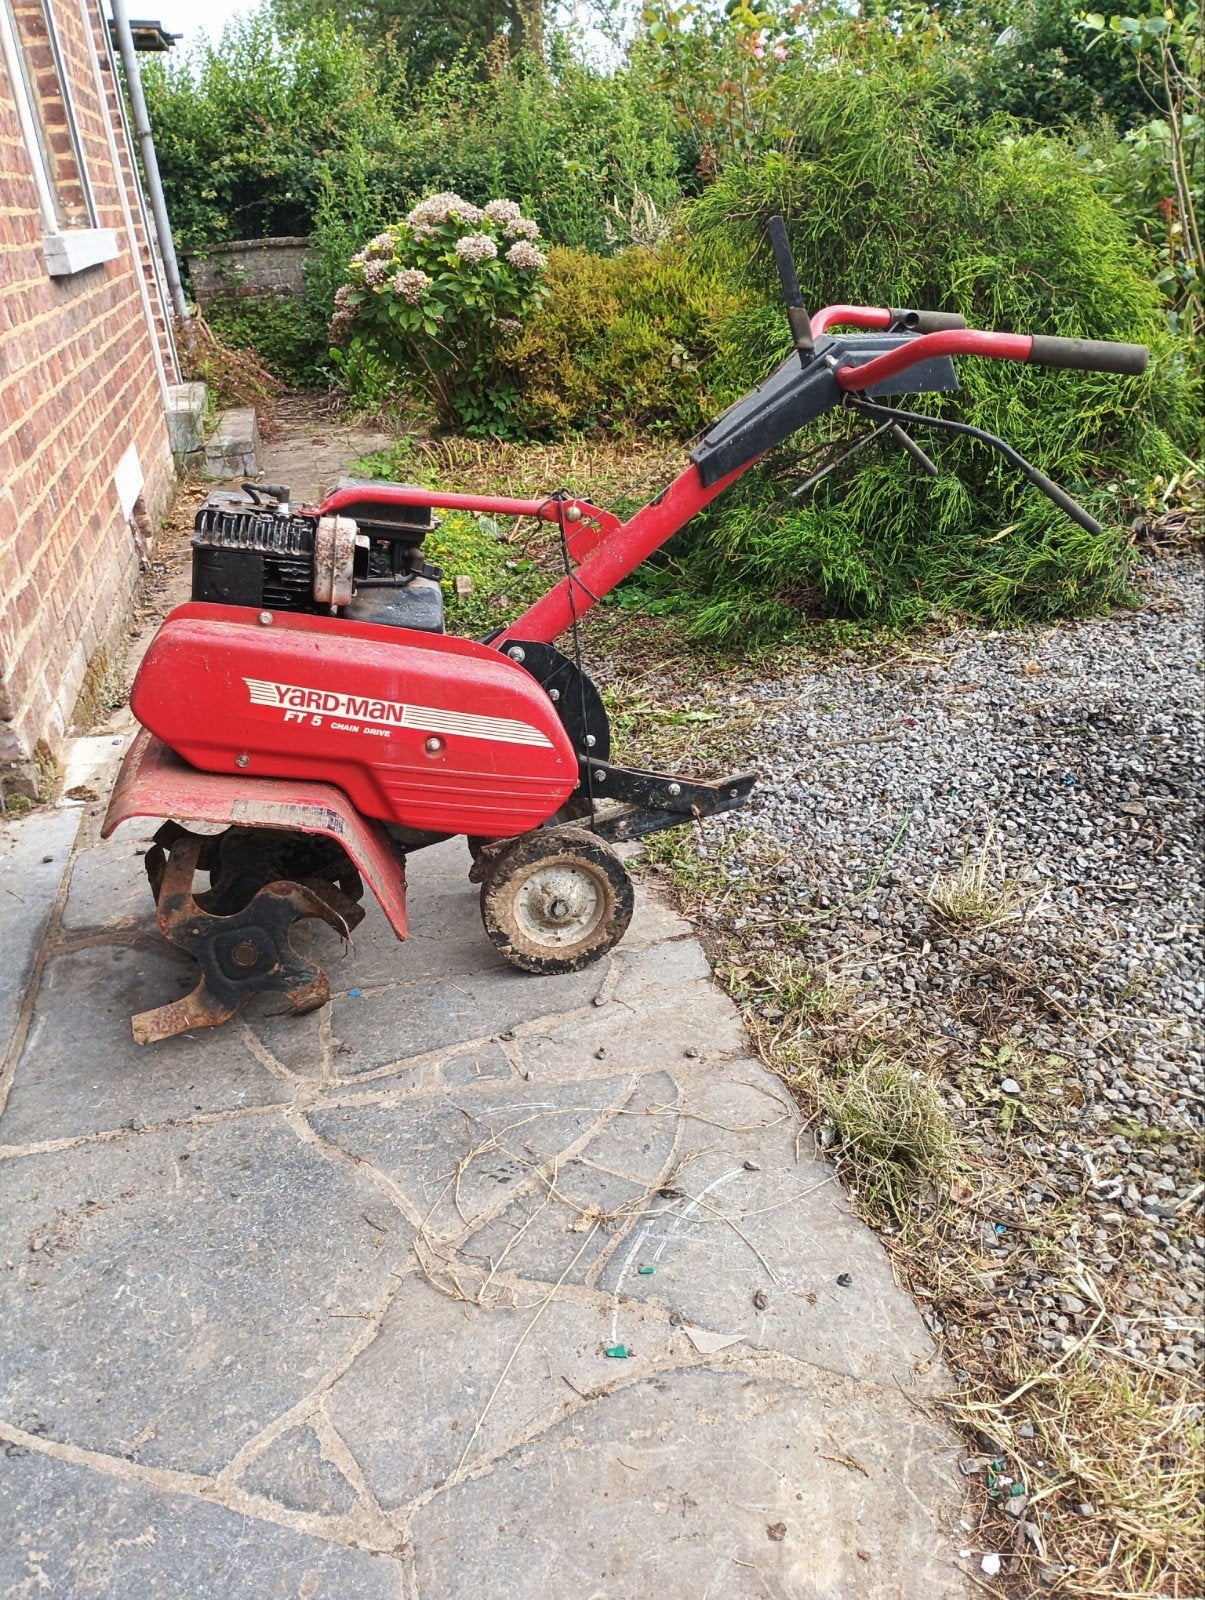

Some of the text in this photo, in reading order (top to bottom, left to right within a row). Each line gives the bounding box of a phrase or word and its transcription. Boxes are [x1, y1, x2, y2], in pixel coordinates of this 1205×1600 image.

[283, 710, 391, 738] FT 5 CHAIN DRIVE
